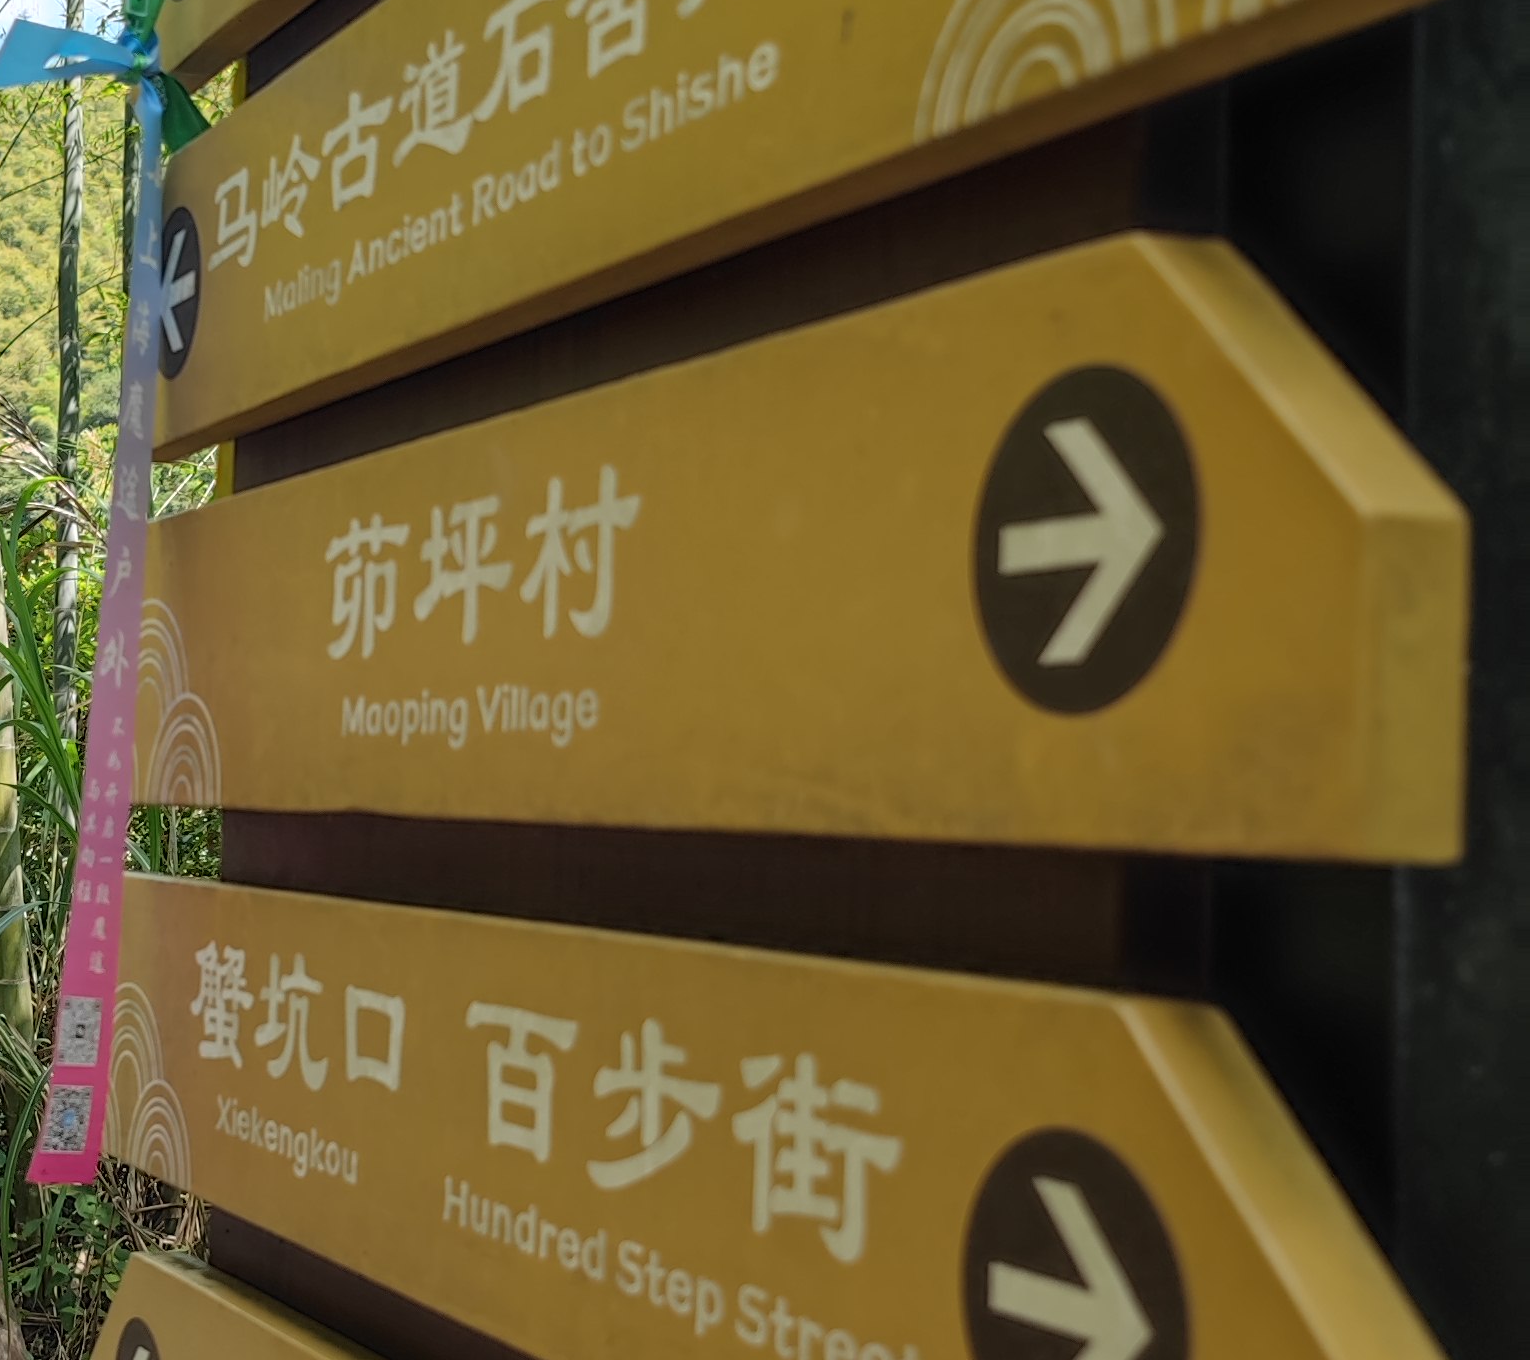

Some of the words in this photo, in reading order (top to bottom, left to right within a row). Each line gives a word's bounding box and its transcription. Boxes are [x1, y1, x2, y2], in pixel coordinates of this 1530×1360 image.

[263, 258, 342, 322] Maling
[347, 193, 463, 286] Ancient
[472, 145, 562, 227] Road
[571, 123, 611, 177] to
[621, 41, 779, 152] Shishe
[325, 464, 641, 660] 茆坪村
[341, 688, 470, 750] Maoping
[476, 683, 600, 747] Village
[188, 940, 407, 1092] 蟹坑口
[465, 1000, 904, 1262] 百步街
[215, 1093, 360, 1185] Xiekengkou
[442, 1175, 608, 1283] Hundred
[616, 1240, 726, 1335] Step
